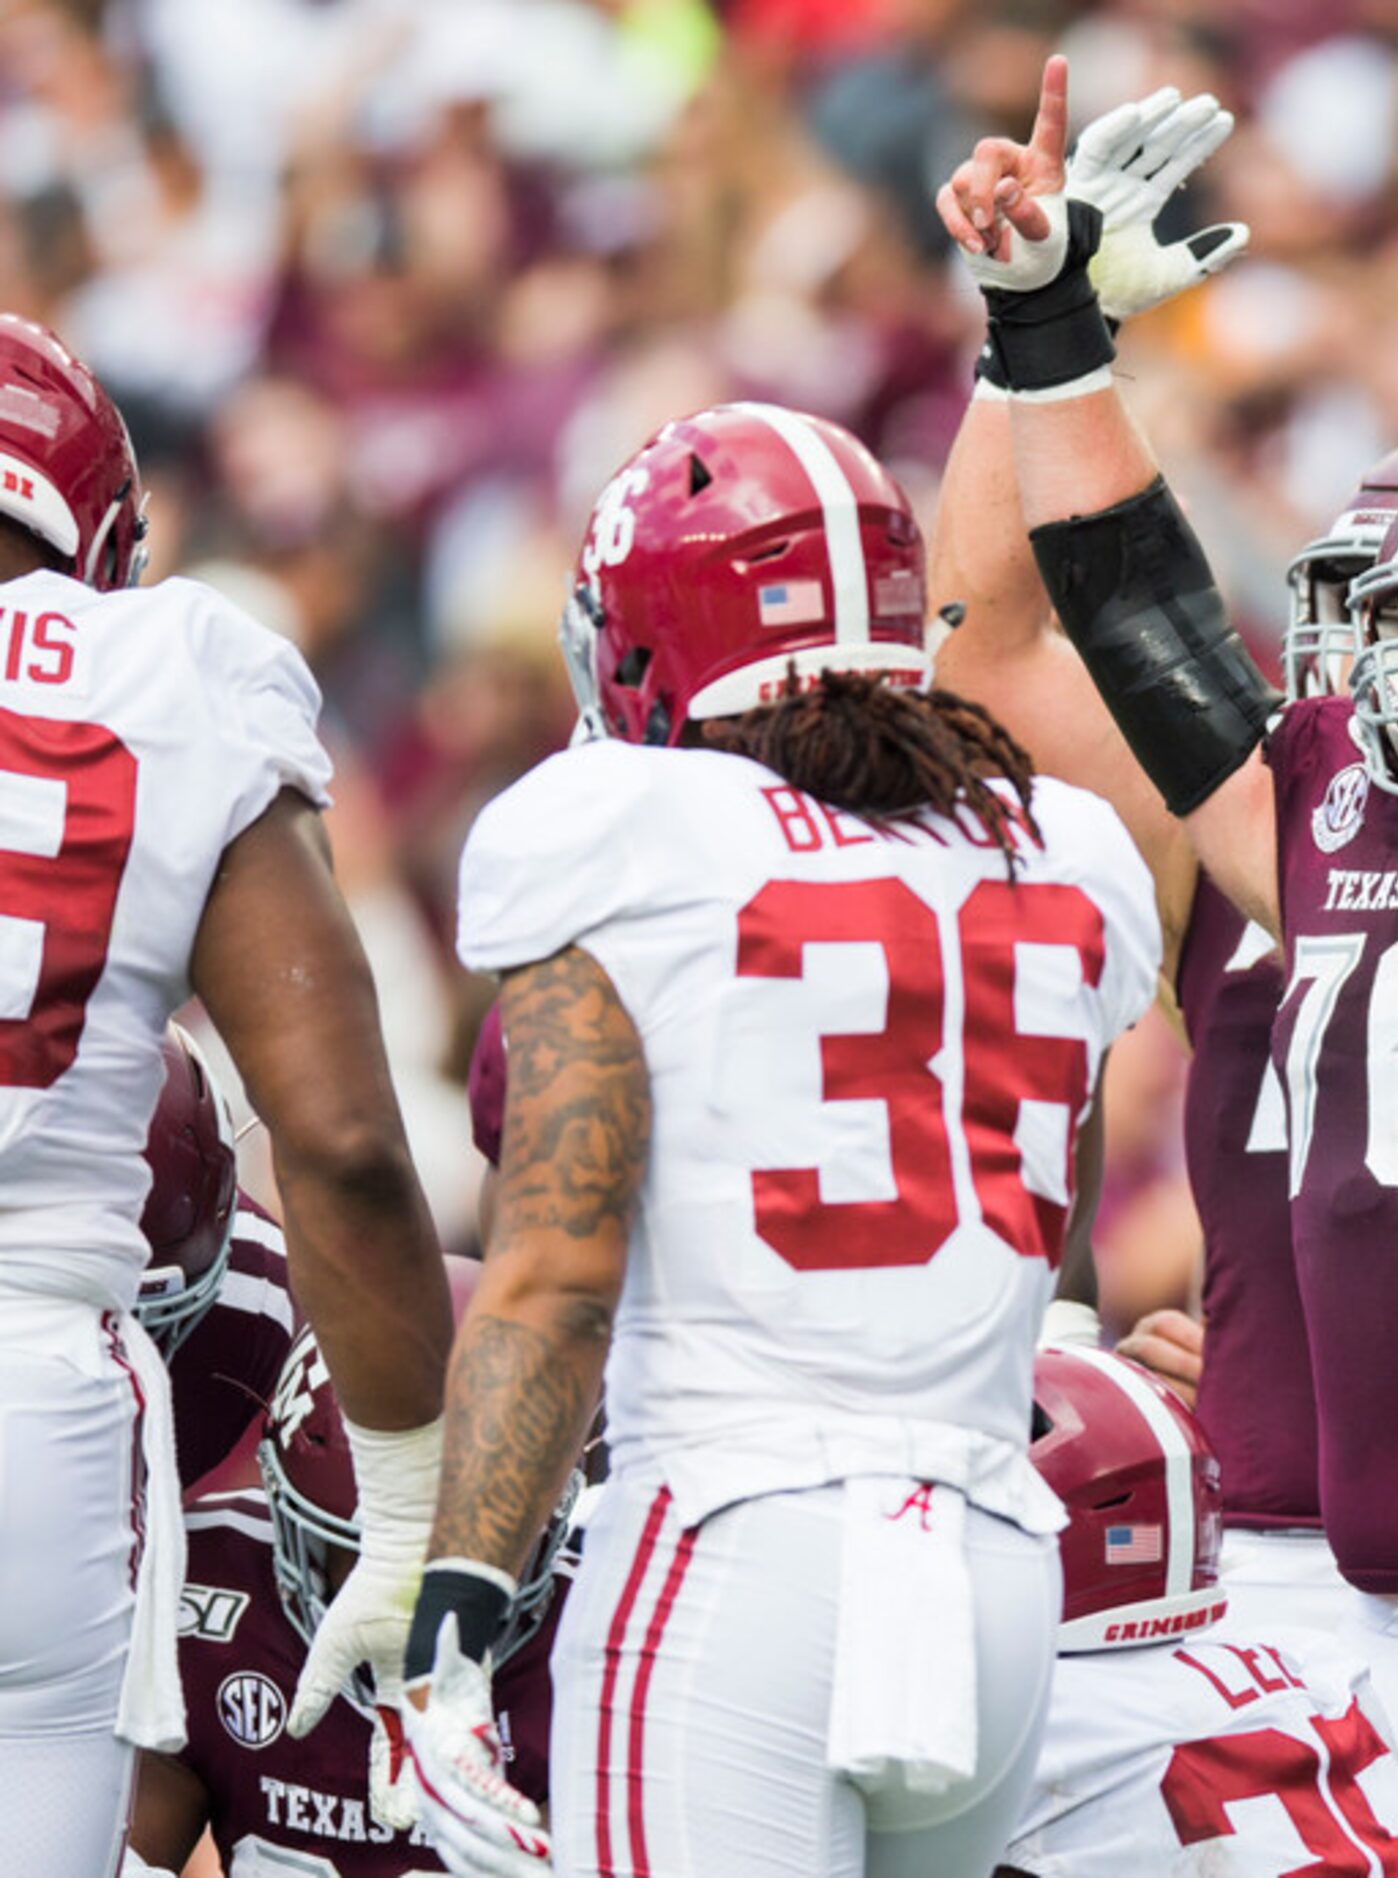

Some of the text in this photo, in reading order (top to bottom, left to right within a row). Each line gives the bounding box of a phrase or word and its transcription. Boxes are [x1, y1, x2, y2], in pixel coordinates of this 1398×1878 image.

[583, 469, 650, 572] 36
[0, 608, 77, 684] IS
[736, 877, 1105, 1273] 36
[1104, 1608, 1208, 1641] CRIMSON
[222, 1677, 282, 1742] SEC
[260, 1774, 395, 1844] TEXAS
